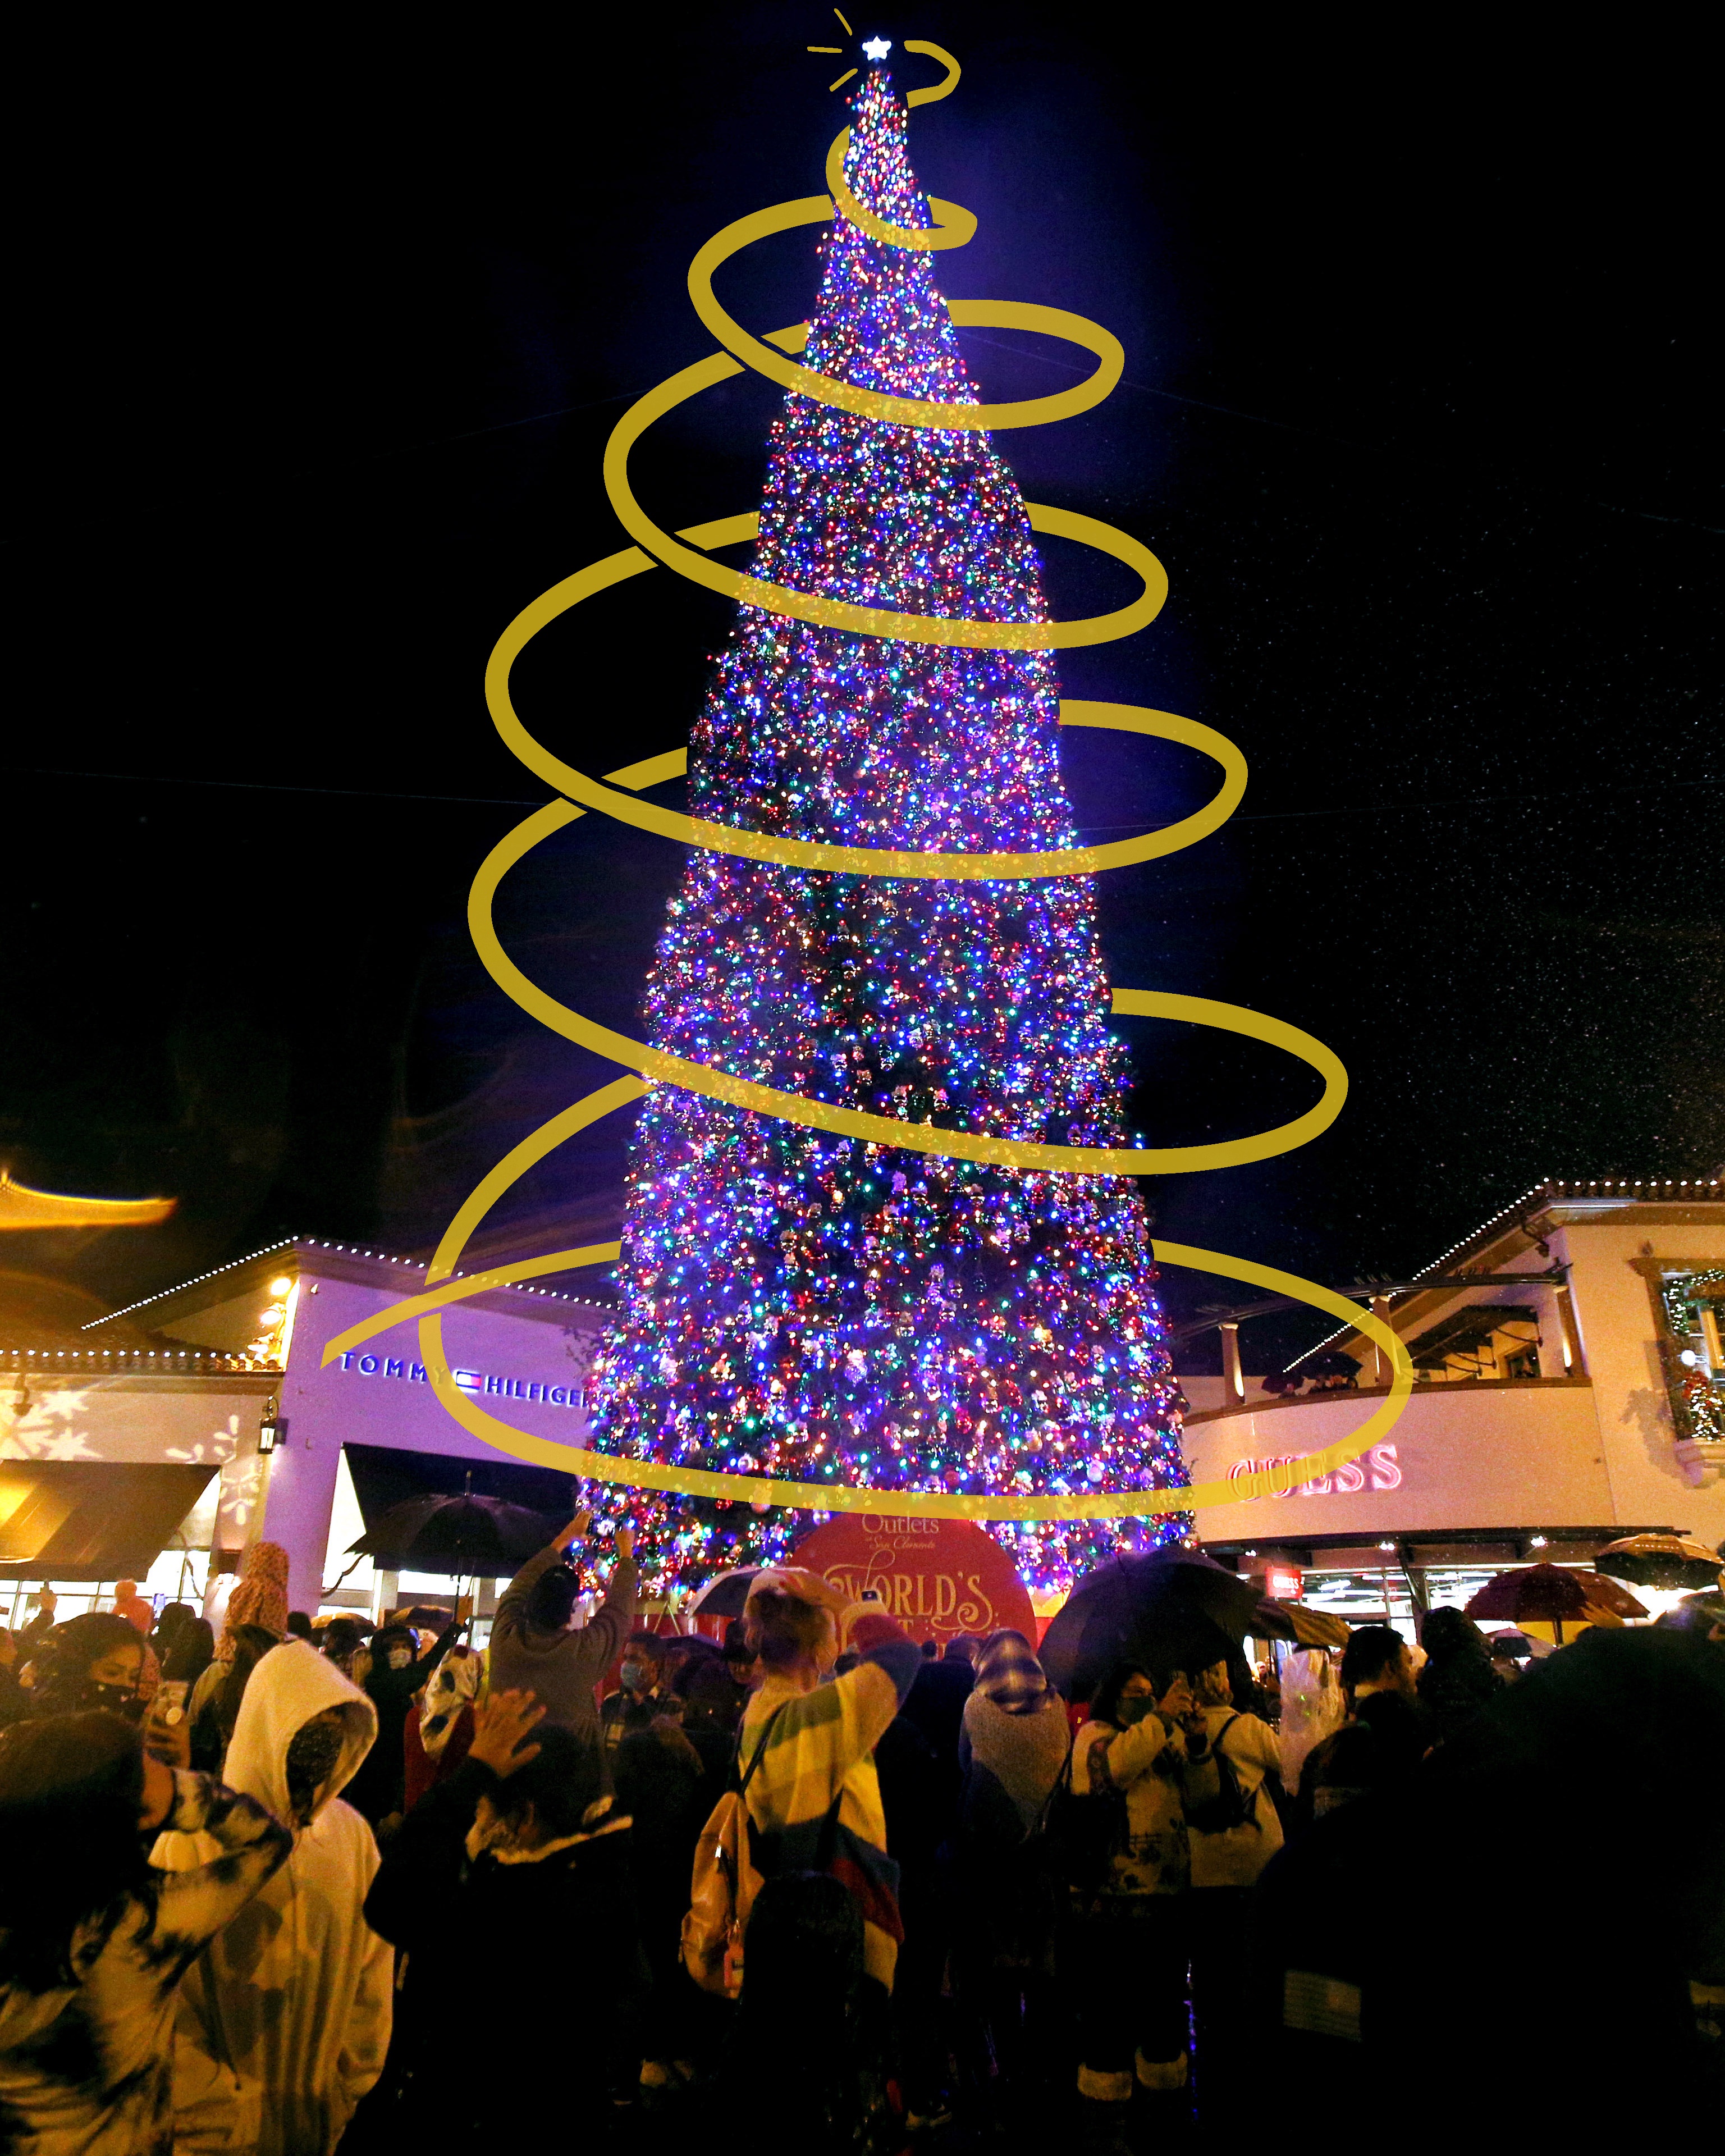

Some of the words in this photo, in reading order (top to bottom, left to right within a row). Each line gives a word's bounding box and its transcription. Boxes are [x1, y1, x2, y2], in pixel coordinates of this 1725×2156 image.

[340, 1350, 450, 1386] TOMMY
[1226, 1445, 1401, 1502] GUESS
[862, 1510, 939, 1534] Outlets
